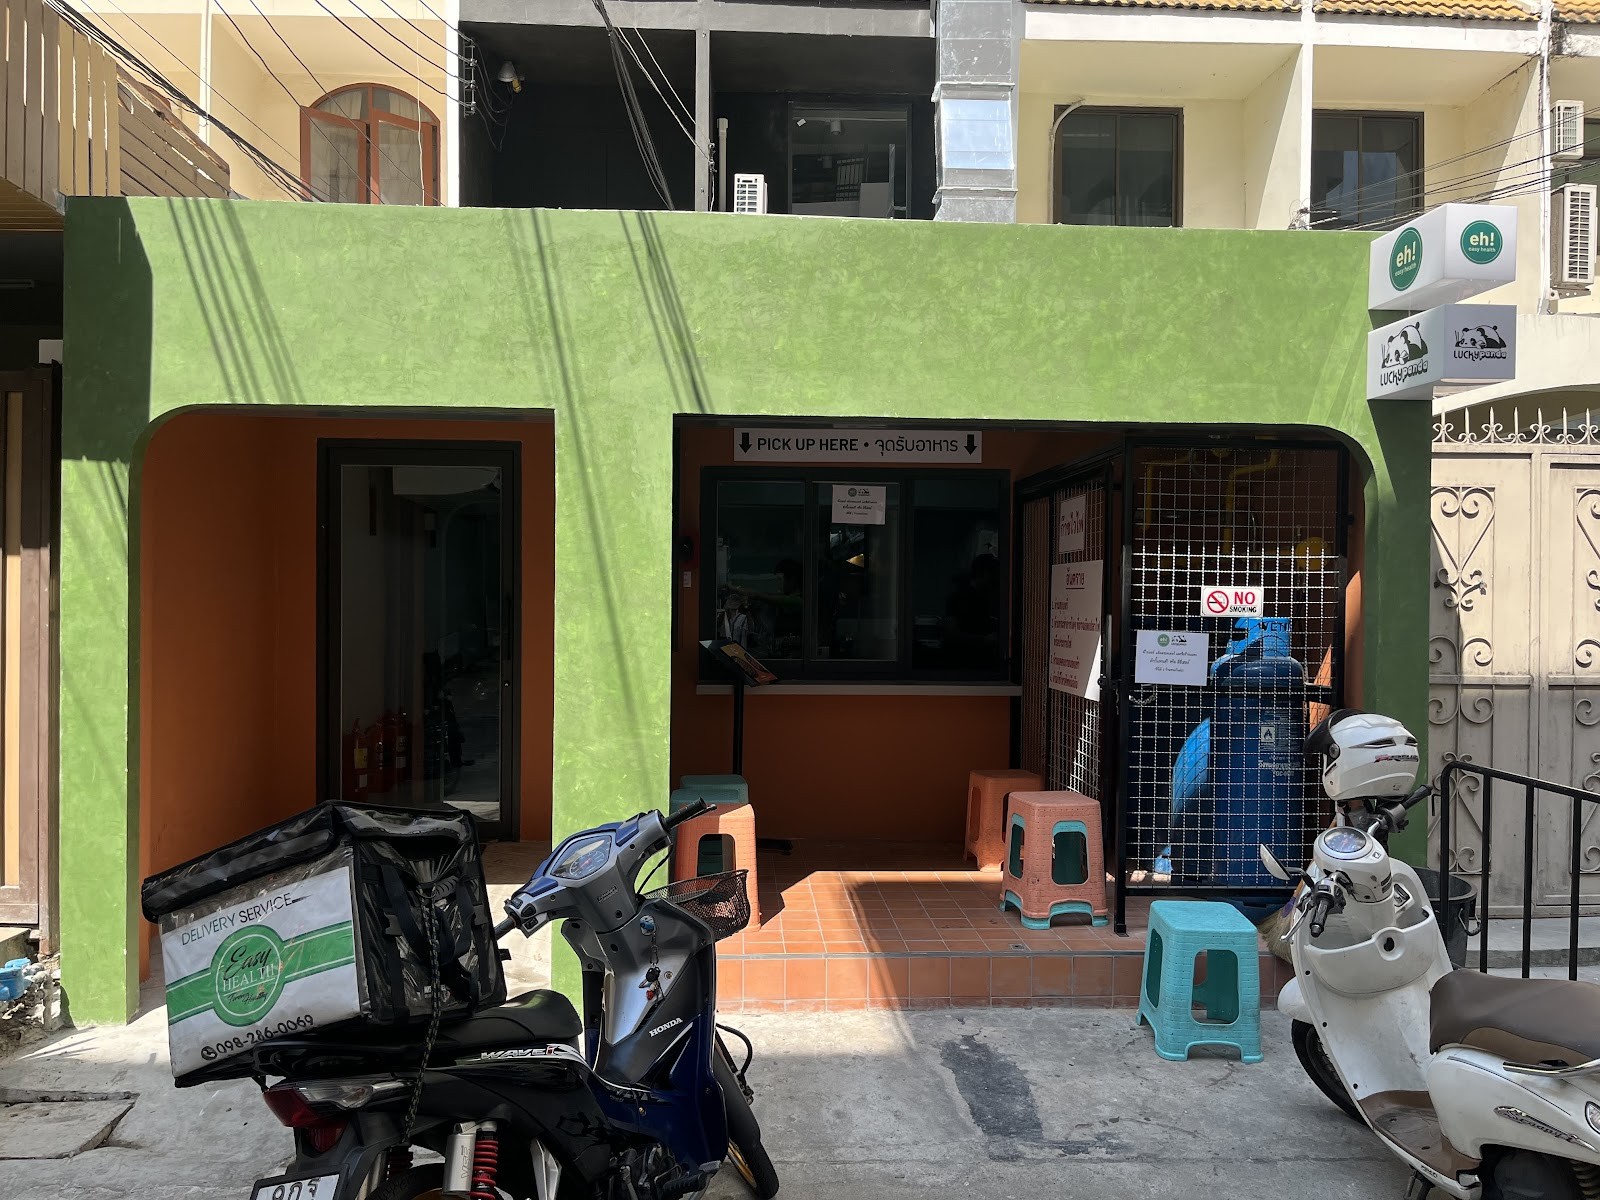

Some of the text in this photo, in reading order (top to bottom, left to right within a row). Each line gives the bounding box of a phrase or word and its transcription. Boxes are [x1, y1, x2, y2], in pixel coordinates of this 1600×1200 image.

[1470, 232, 1495, 246] eh!
[1396, 241, 1417, 268] eh!
[1394, 263, 1417, 277] easy health
[757, 435, 958, 456] PICK UP HERE จุดรับอาหาร
[1234, 591, 1256, 605] NO
[181, 892, 293, 946] DELIVERY SERVICE
[223, 945, 272, 981] Easy
[222, 963, 275, 992] HEALTH
[216, 1014, 313, 1054] 098-286-0069
[648, 1017, 684, 1038] HONDA
